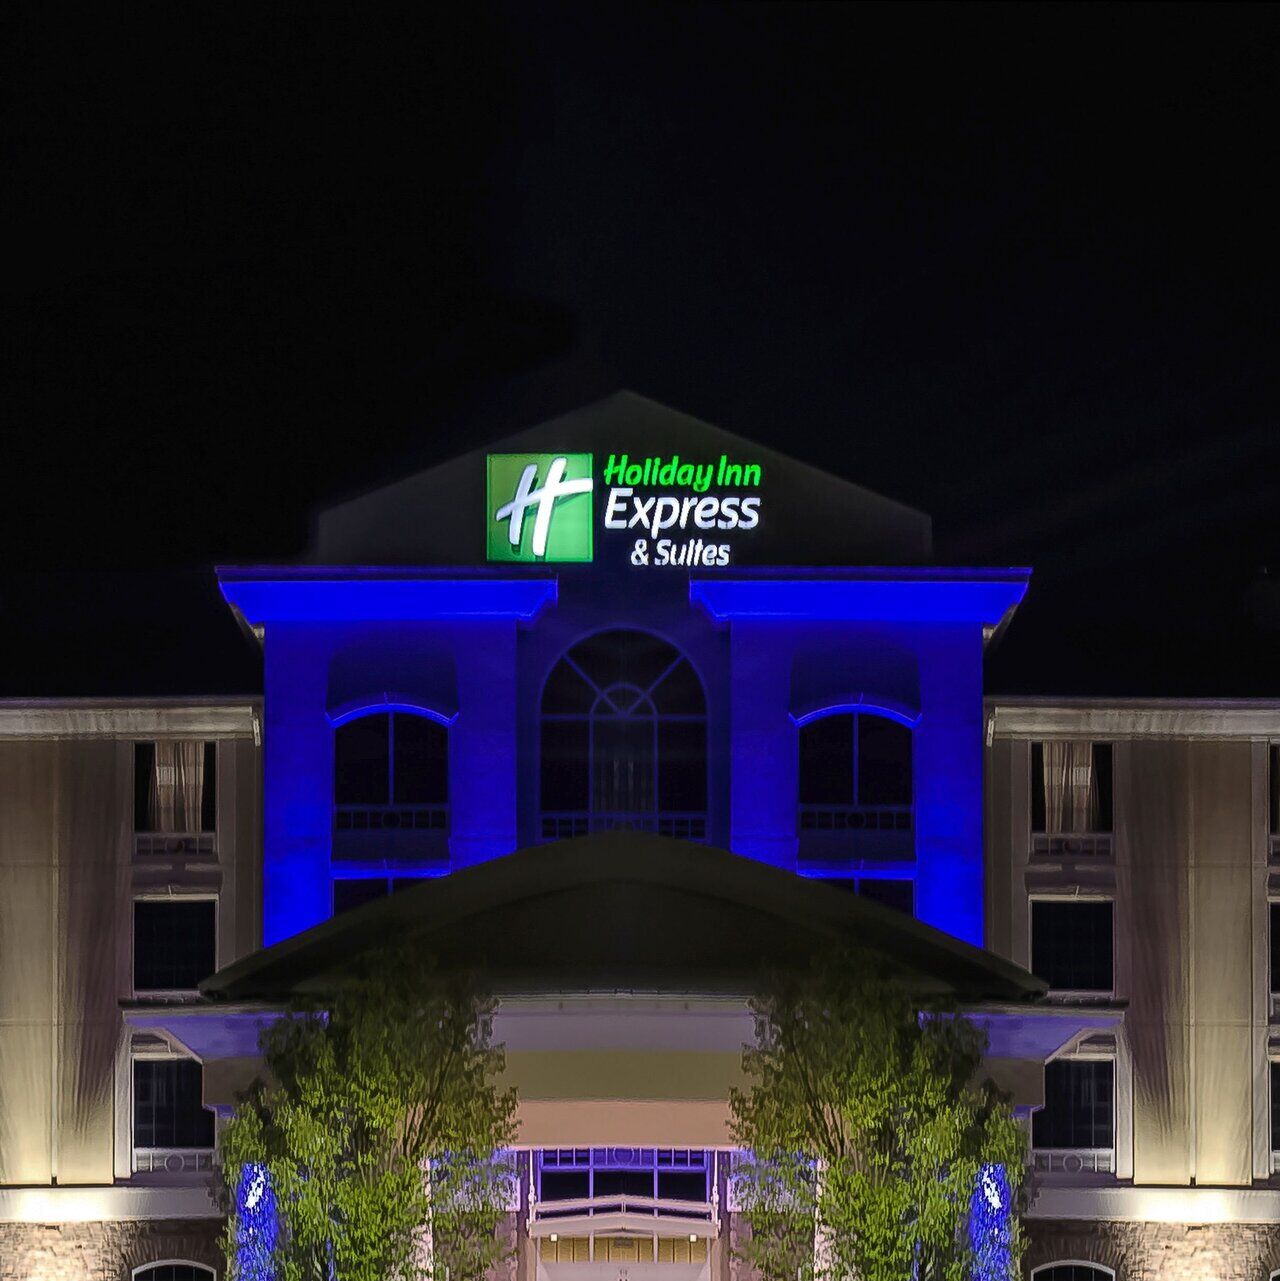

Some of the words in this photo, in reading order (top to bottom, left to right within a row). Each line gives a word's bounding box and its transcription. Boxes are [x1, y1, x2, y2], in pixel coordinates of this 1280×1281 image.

[604, 455, 714, 492] Holiday
[717, 455, 761, 486] Inn
[605, 488, 761, 540] Express
[631, 539, 649, 566] &
[654, 539, 731, 566] Suites
